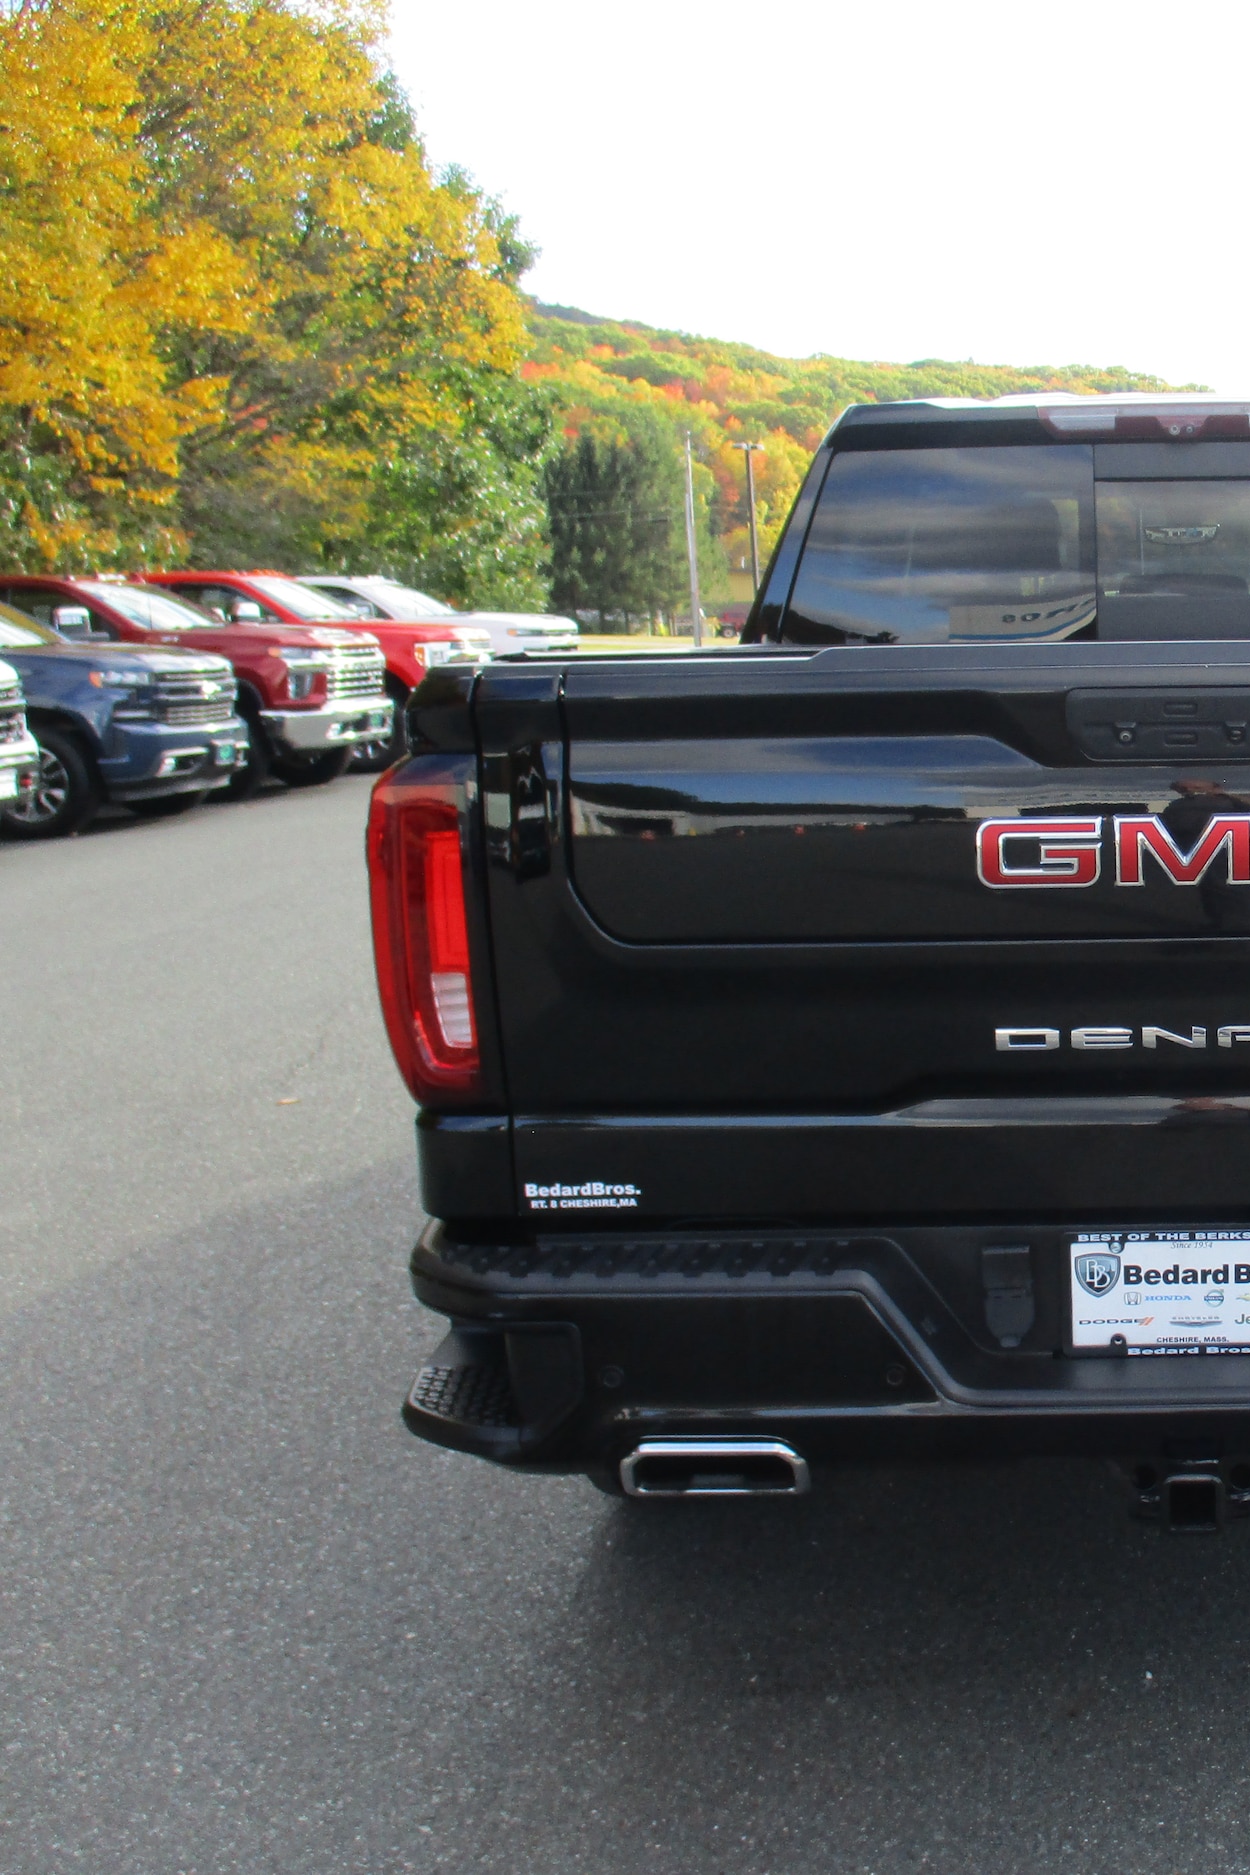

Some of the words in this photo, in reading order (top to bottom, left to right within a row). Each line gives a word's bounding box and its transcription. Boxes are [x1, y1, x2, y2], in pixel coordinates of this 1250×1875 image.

[530, 1200, 548, 1209] RT.
[550, 1200, 557, 1208] 8
[1077, 1233, 1122, 1242] BEST
[1127, 1233, 1150, 1241] OF
[1155, 1232, 1190, 1240] THE
[1123, 1263, 1229, 1285] Bedard
[1127, 1347, 1199, 1355] Bedard
